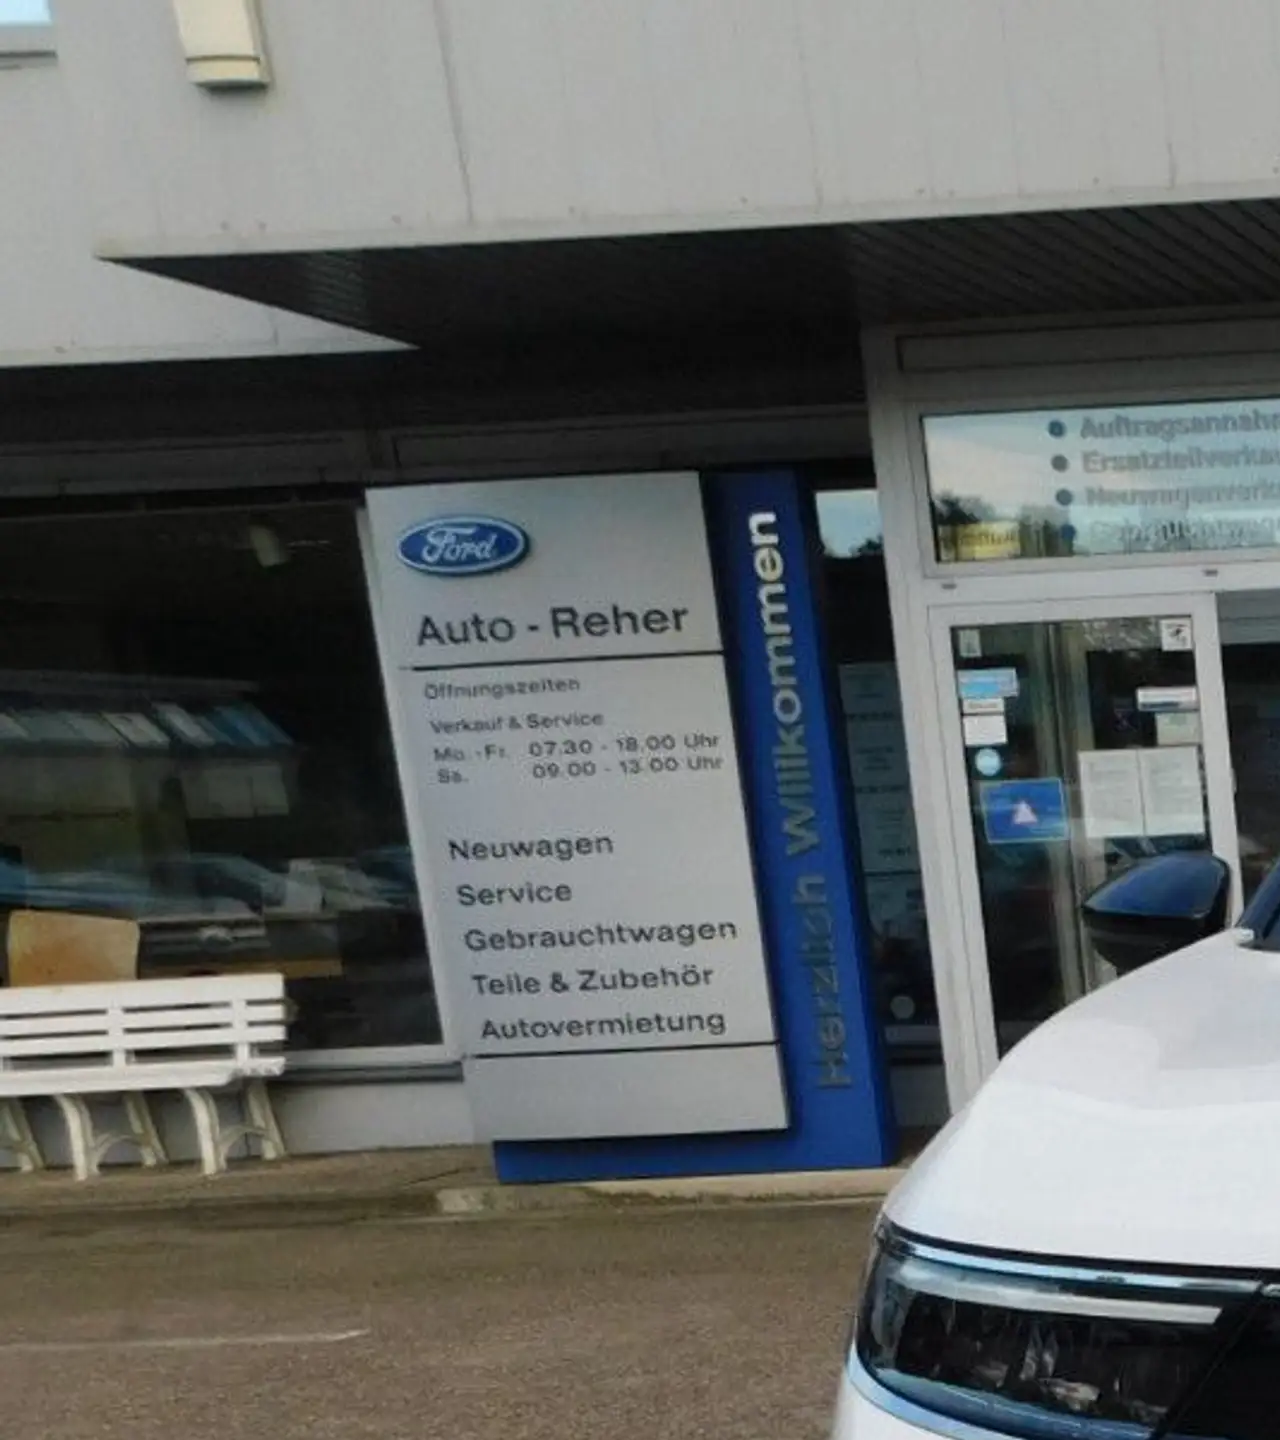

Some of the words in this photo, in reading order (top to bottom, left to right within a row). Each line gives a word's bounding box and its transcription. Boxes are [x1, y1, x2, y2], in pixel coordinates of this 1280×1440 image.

[422, 526, 498, 563] Ford
[417, 613, 515, 646] Auto
[549, 604, 689, 639] Reher
[748, 511, 822, 857] Willkommen
[430, 716, 502, 734] Verkauf
[526, 711, 604, 729] Service
[684, 732, 719, 748] Uhr
[687, 754, 723, 770] Uhr
[449, 836, 613, 861] Neuwagen
[457, 882, 572, 905] Service
[464, 920, 738, 951] Gebrauchtwagen
[472, 973, 540, 996] Teile
[550, 971, 569, 993] &
[577, 964, 714, 992] Zubehör
[481, 1011, 726, 1040] Autovermietung
